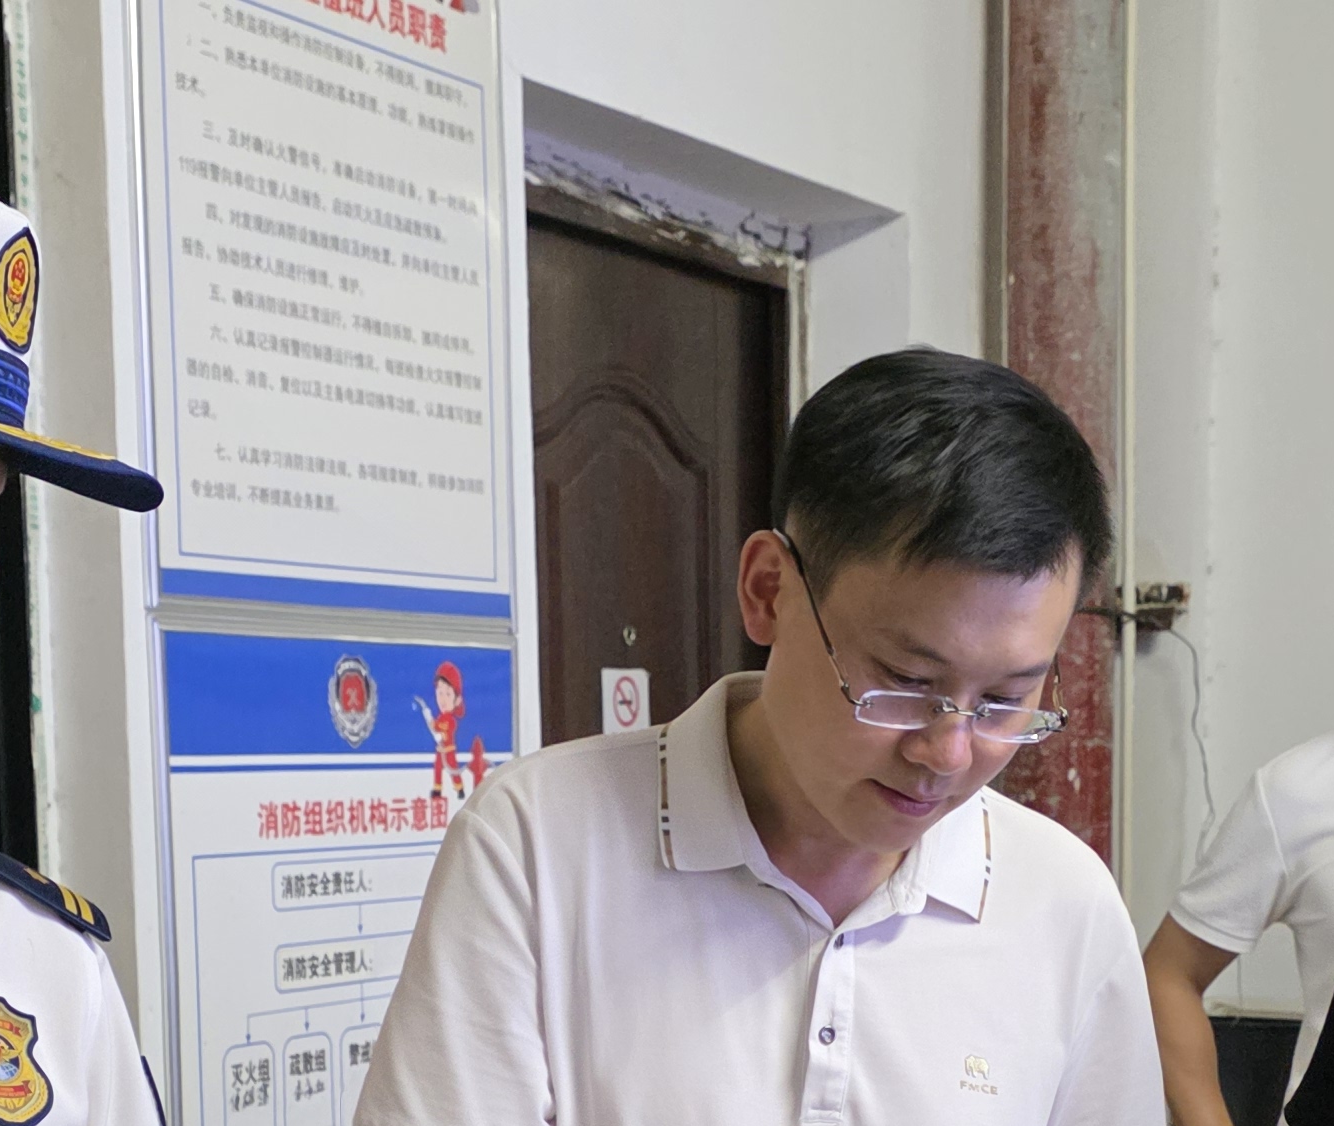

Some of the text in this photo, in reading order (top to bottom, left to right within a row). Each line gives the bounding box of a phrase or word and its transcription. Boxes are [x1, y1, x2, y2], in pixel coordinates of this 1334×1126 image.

[257, 796, 449, 840] 消防组织机构示意图
[230, 1058, 271, 1088] 灭火组
